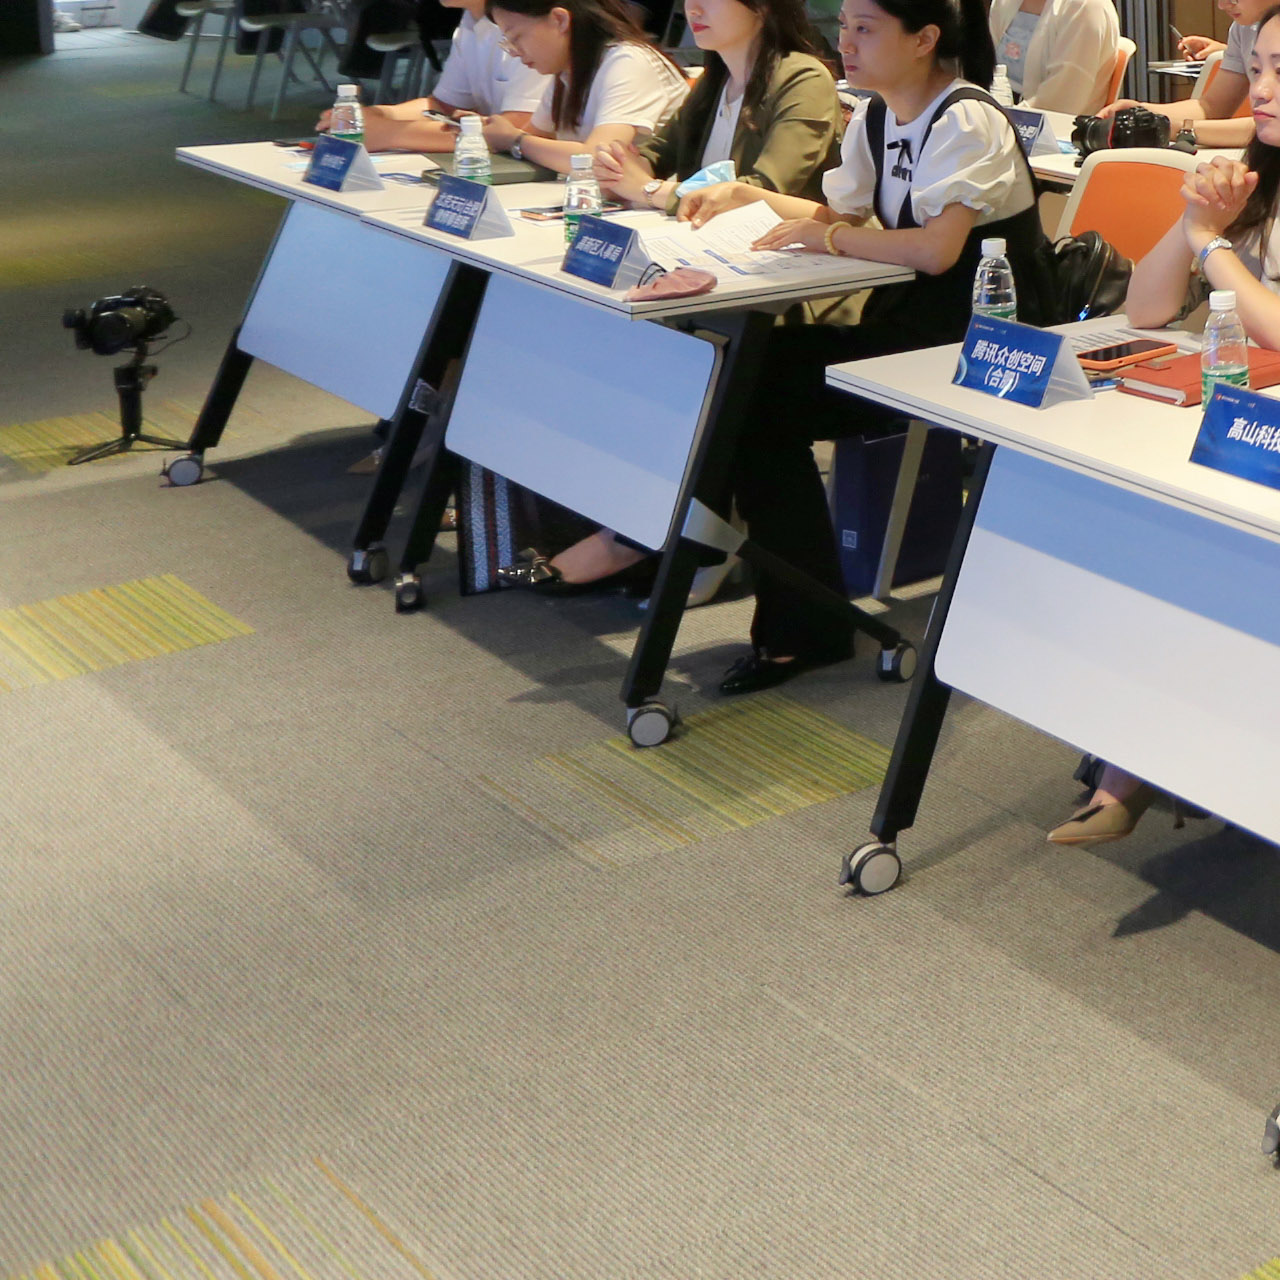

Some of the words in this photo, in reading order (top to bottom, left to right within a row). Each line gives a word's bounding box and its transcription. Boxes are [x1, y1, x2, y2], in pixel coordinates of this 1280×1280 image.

[971, 340, 1047, 376] 腾讯众创空间
